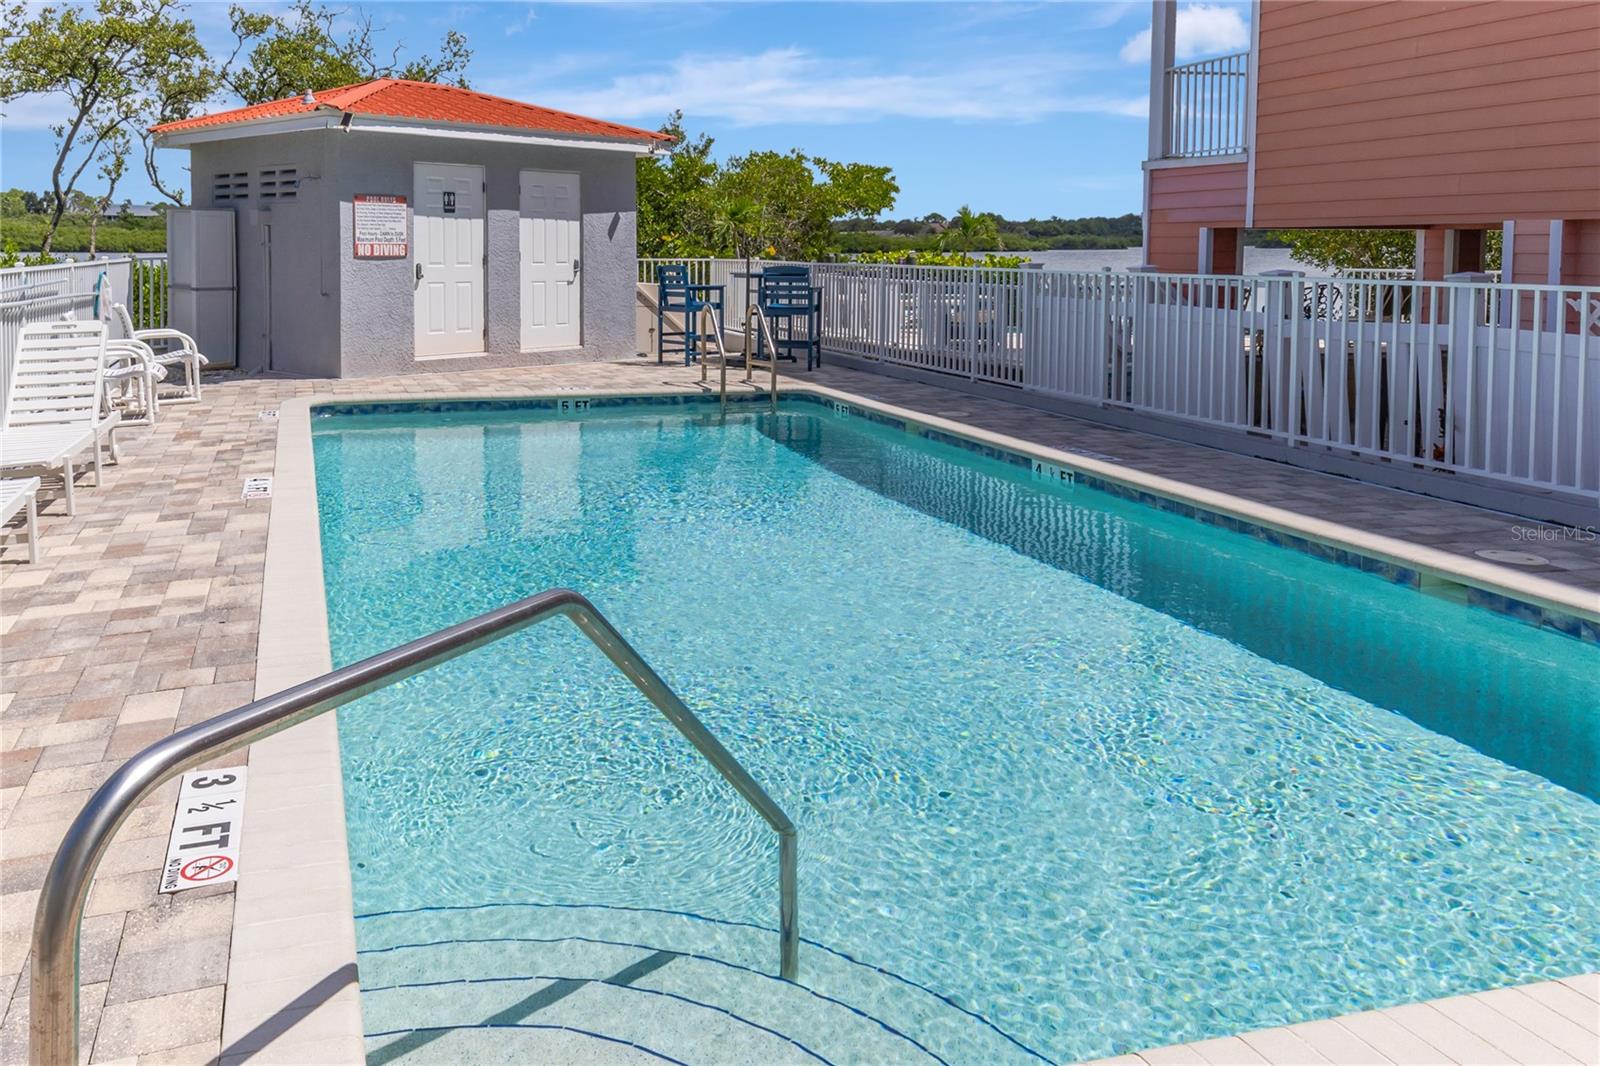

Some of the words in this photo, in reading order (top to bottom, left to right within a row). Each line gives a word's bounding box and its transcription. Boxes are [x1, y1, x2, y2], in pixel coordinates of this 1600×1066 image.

[358, 244, 371, 256] NO
[373, 244, 406, 256] DIVING
[575, 400, 590, 408] FT
[1060, 470, 1073, 483] FT
[191, 774, 237, 789] 3
[179, 821, 231, 850] FT
[168, 858, 182, 868] NO
[164, 867, 180, 890] DIVING
